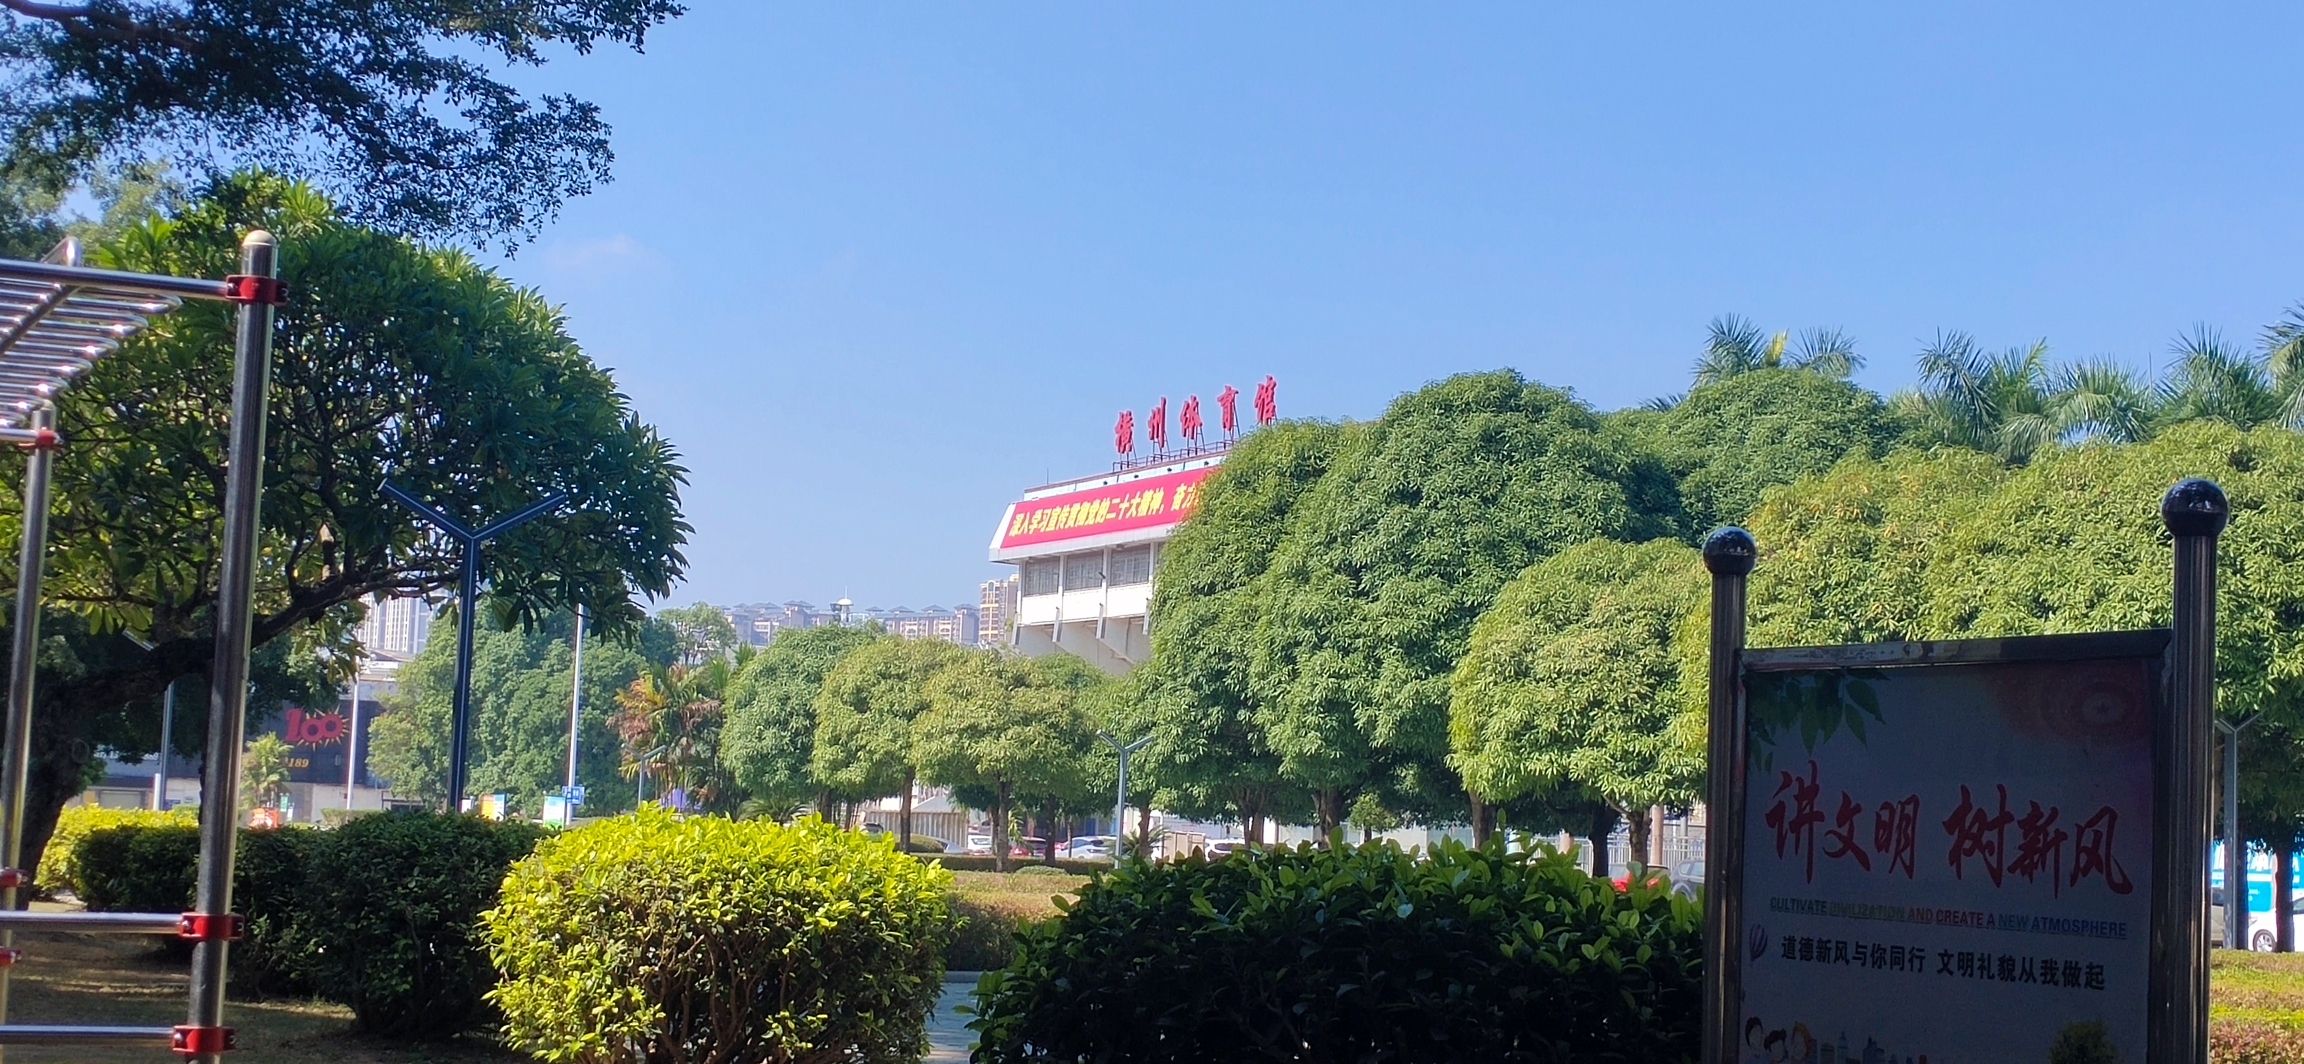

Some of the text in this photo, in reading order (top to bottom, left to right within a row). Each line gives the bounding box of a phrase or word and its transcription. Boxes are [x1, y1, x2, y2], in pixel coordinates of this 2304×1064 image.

[1115, 375, 1277, 454] 横州体育馆
[284, 757, 310, 768] 189
[1765, 760, 2134, 899] 讲文明 树新风
[1769, 896, 1827, 914] CULTIVATE
[1908, 907, 1933, 922] AND
[1935, 909, 1984, 926] CREATE
[1986, 913, 1996, 926] A
[1998, 914, 2030, 928] NEW
[2032, 917, 2127, 937] ATMOSPHERE
[1781, 934, 2105, 990] 道德新风与你同行 文明礼貌从我做起
